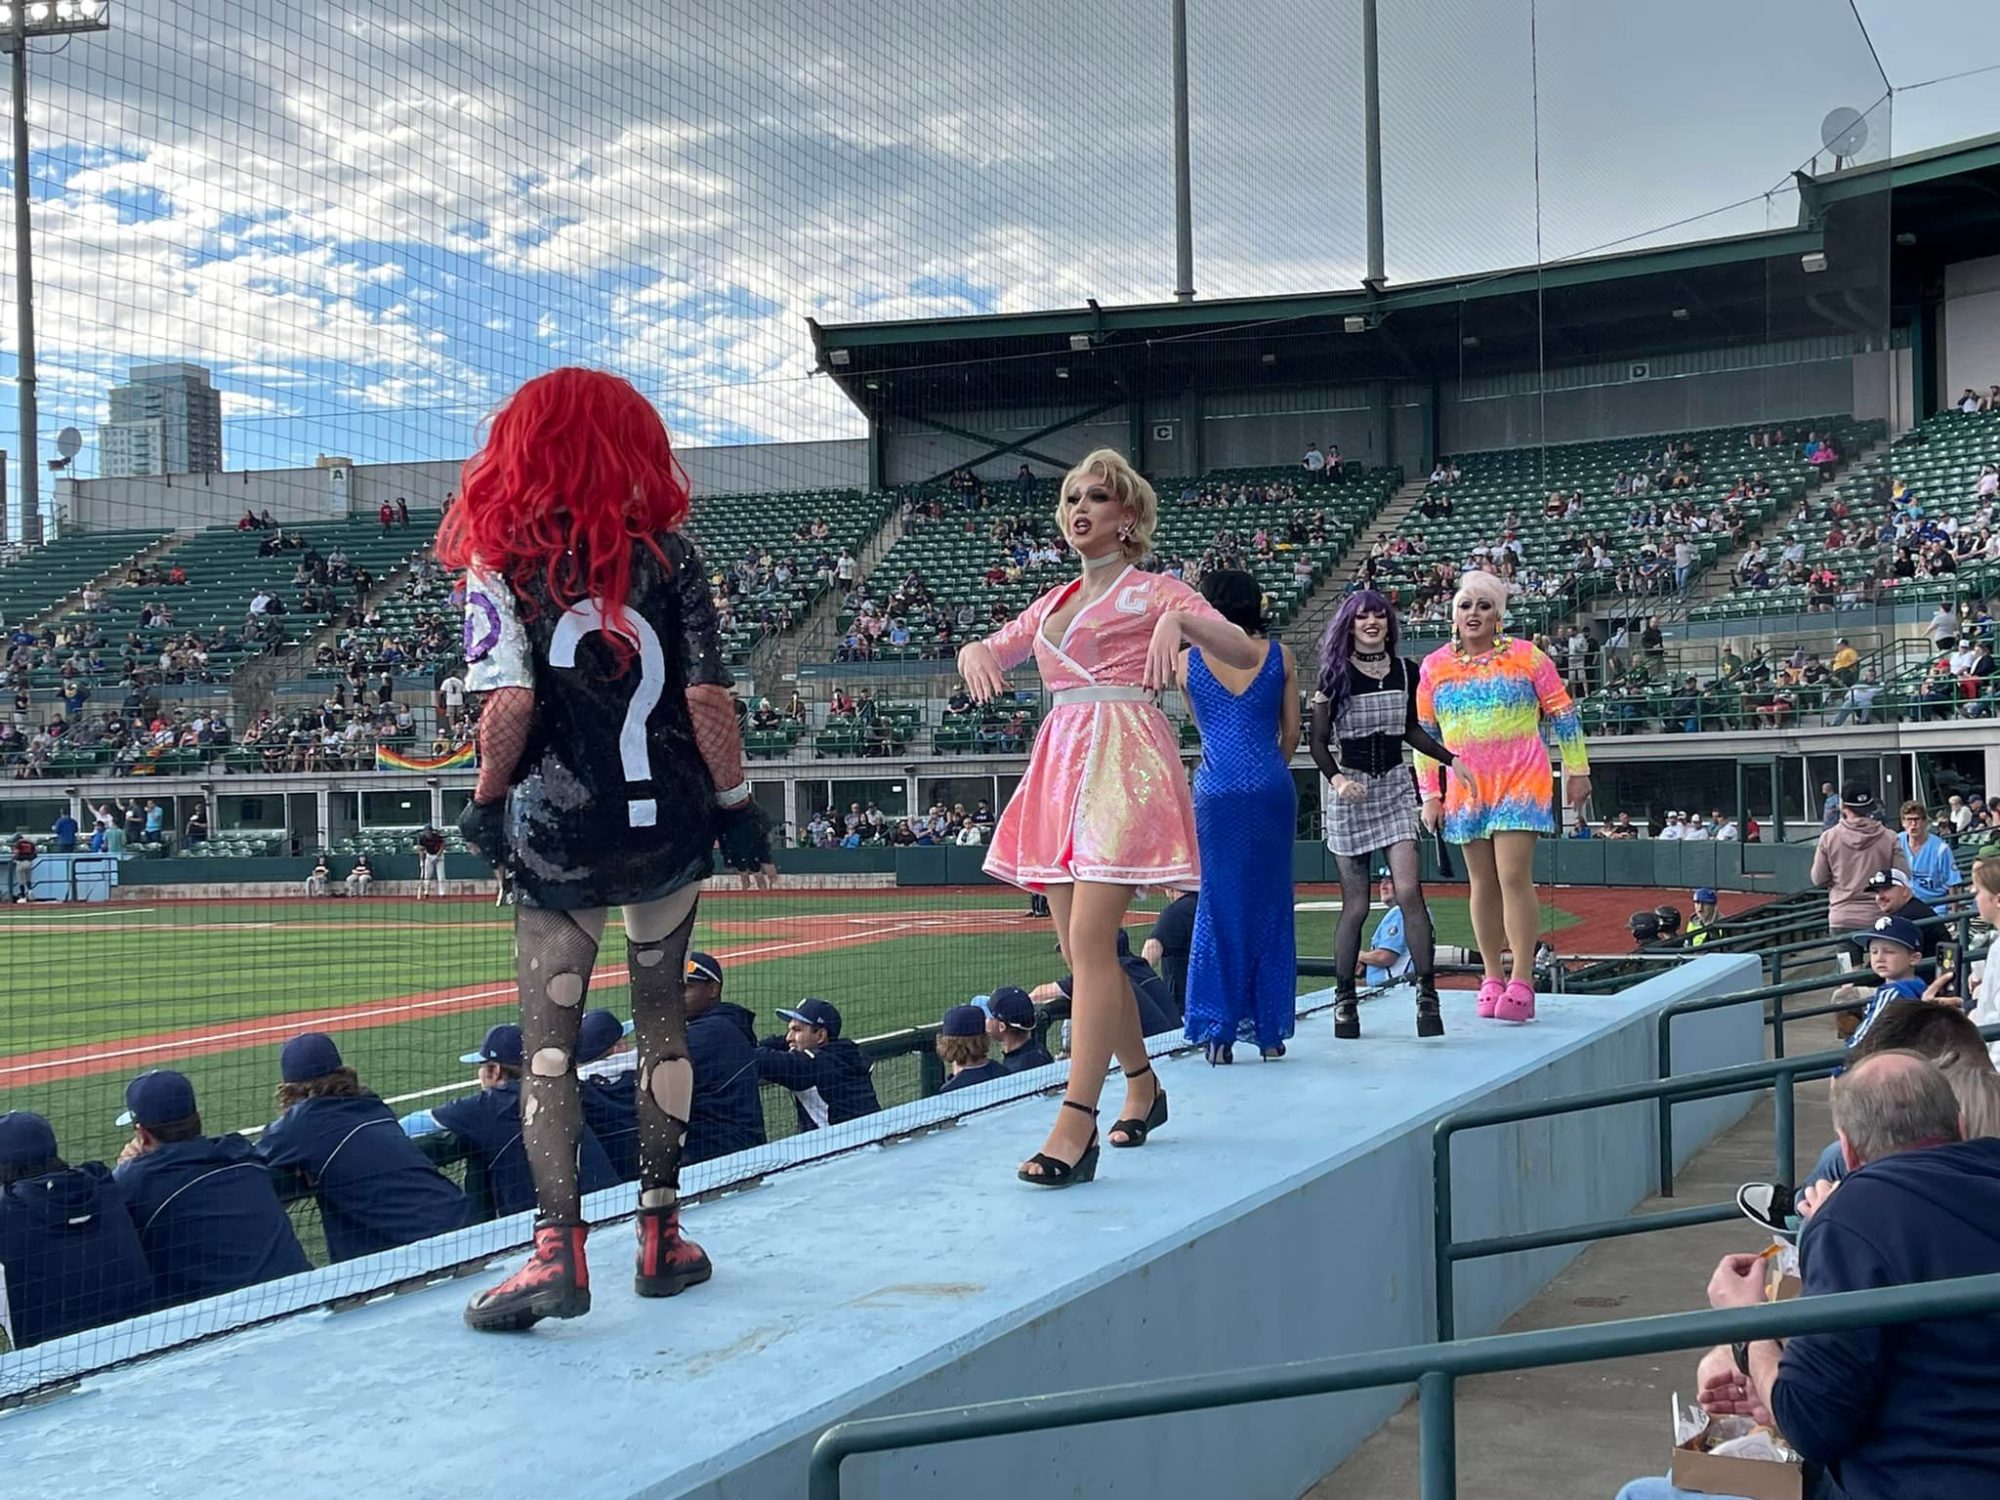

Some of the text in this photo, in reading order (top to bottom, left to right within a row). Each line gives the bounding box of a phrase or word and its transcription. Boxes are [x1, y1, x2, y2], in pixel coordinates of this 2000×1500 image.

[1632, 365, 1647, 378] D
[1157, 427, 1170, 439] C
[332, 469, 344, 480] A
[1115, 580, 1150, 615] C
